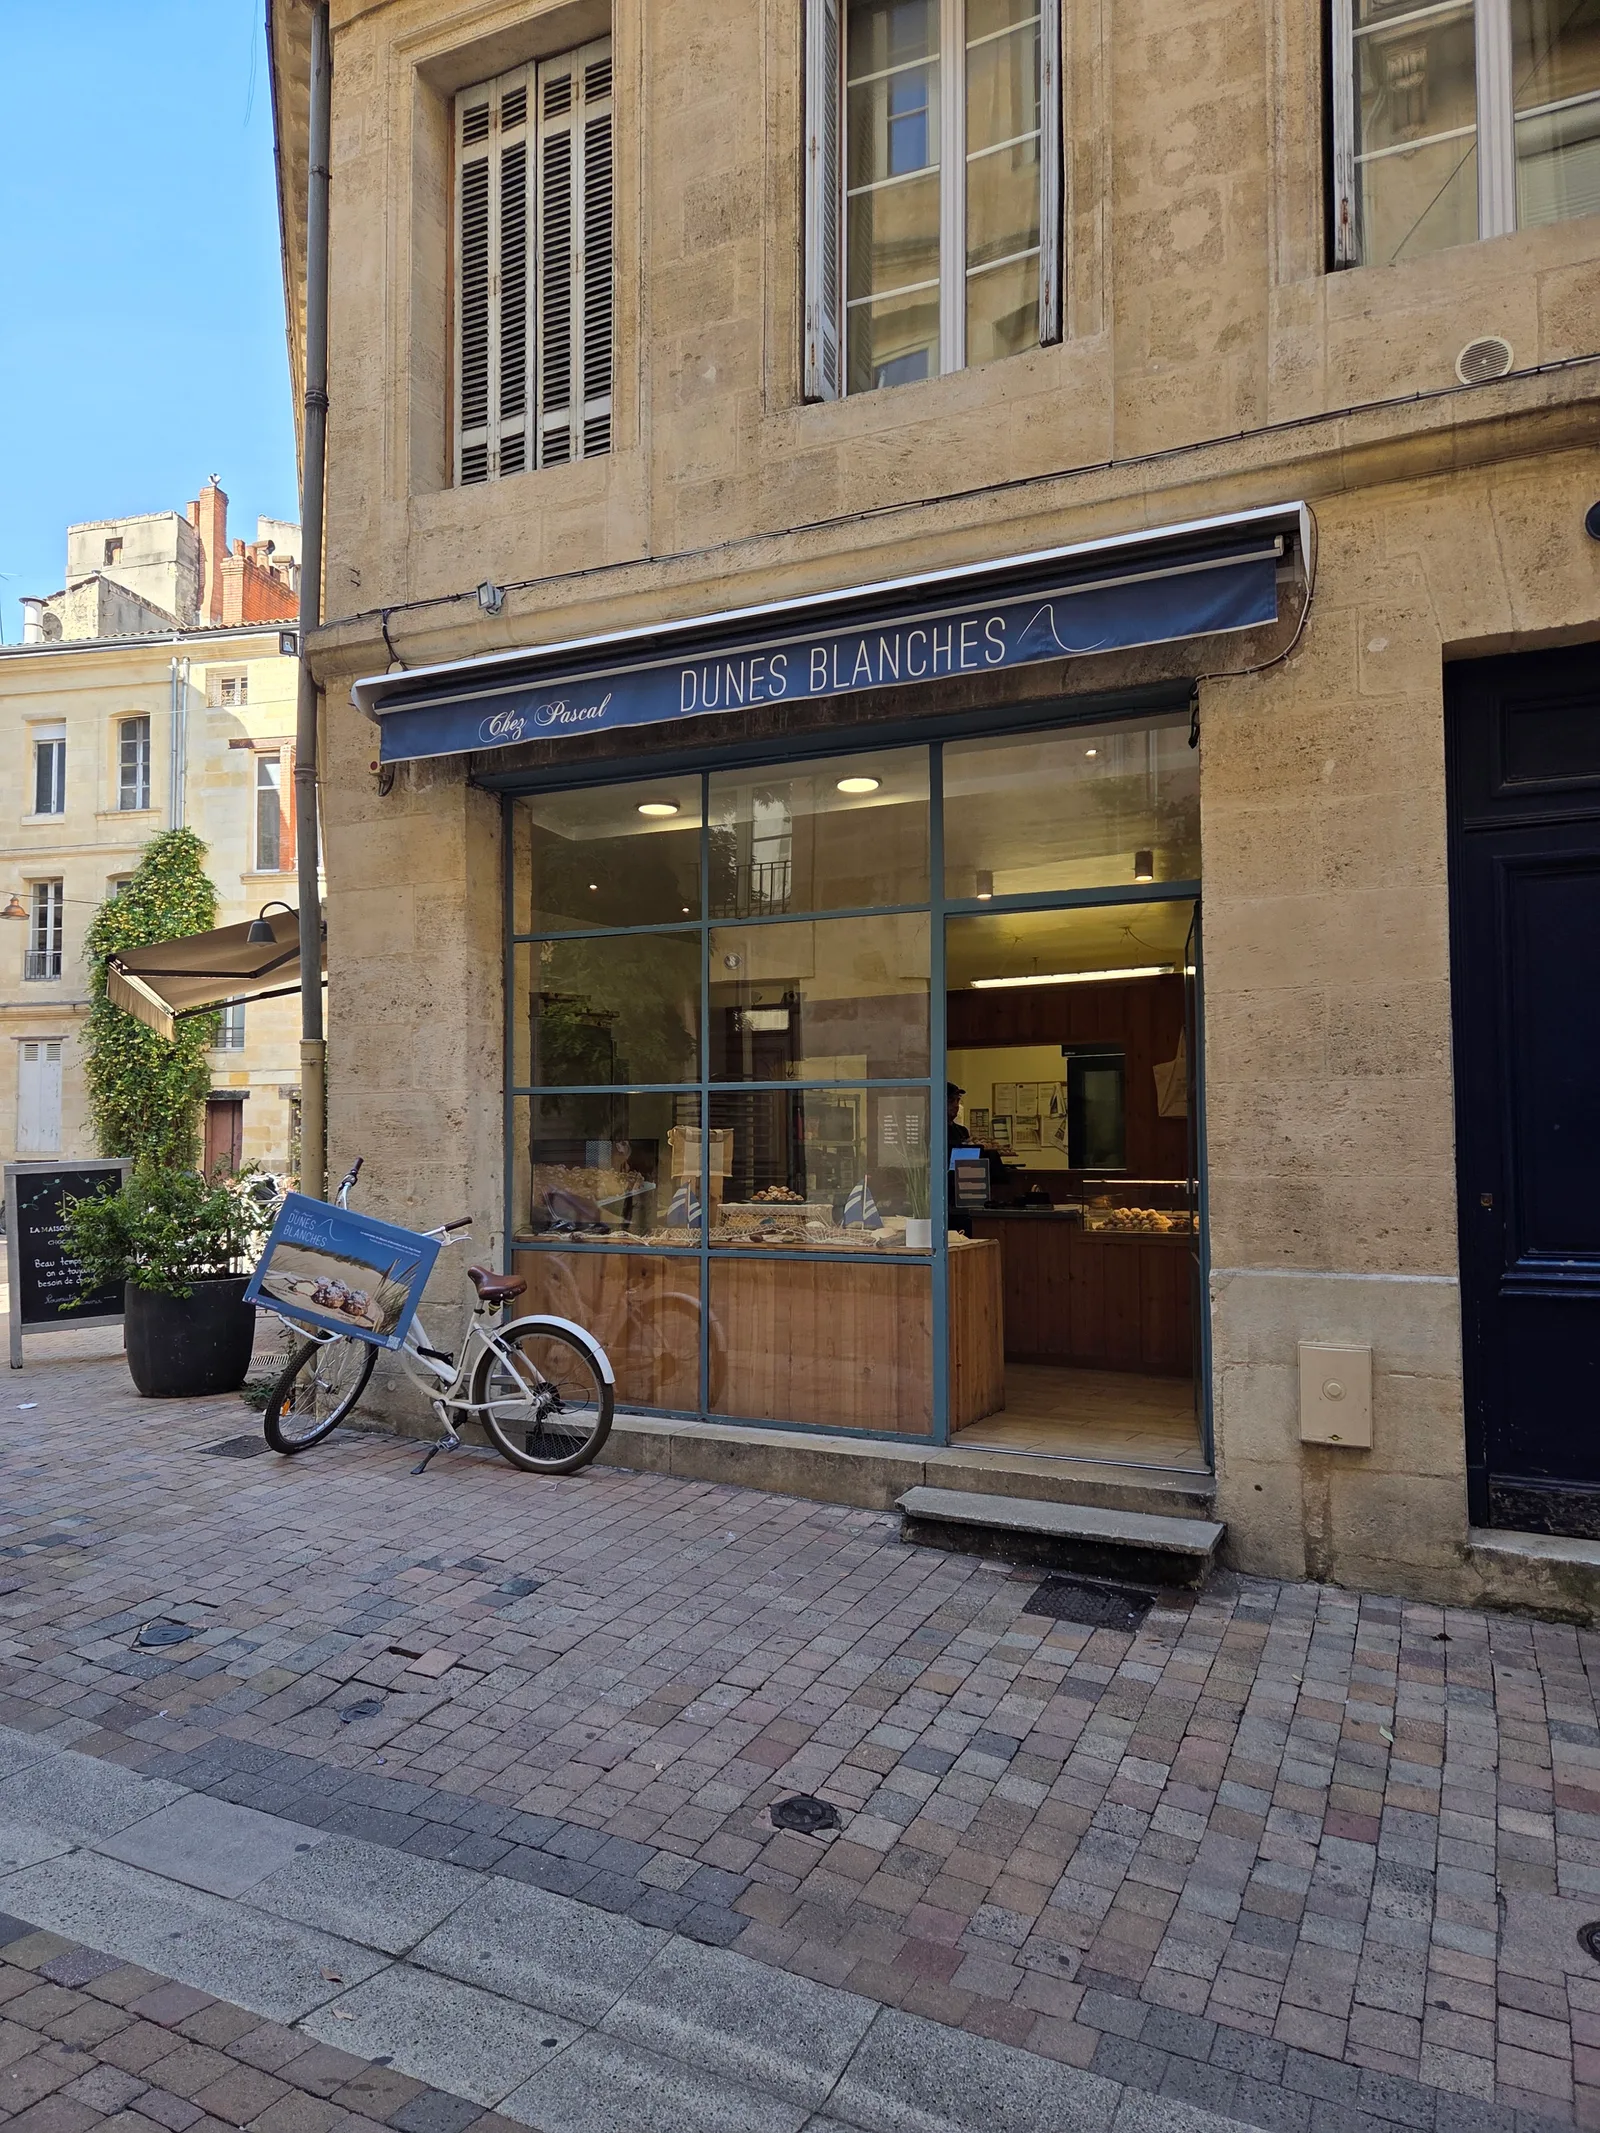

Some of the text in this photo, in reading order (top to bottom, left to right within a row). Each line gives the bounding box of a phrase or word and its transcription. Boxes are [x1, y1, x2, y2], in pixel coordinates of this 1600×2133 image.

[478, 616, 1007, 743] Chez Pascal DUNES BLANCHES
[287, 1212, 317, 1231] DUNES
[29, 1226, 40, 1234] LA
[283, 1224, 328, 1248] BLANCHES
[34, 1258, 55, 1269] Beau
[46, 1269, 56, 1278] on
[37, 1279, 63, 1288] besoin
[64, 1276, 74, 1285] de
